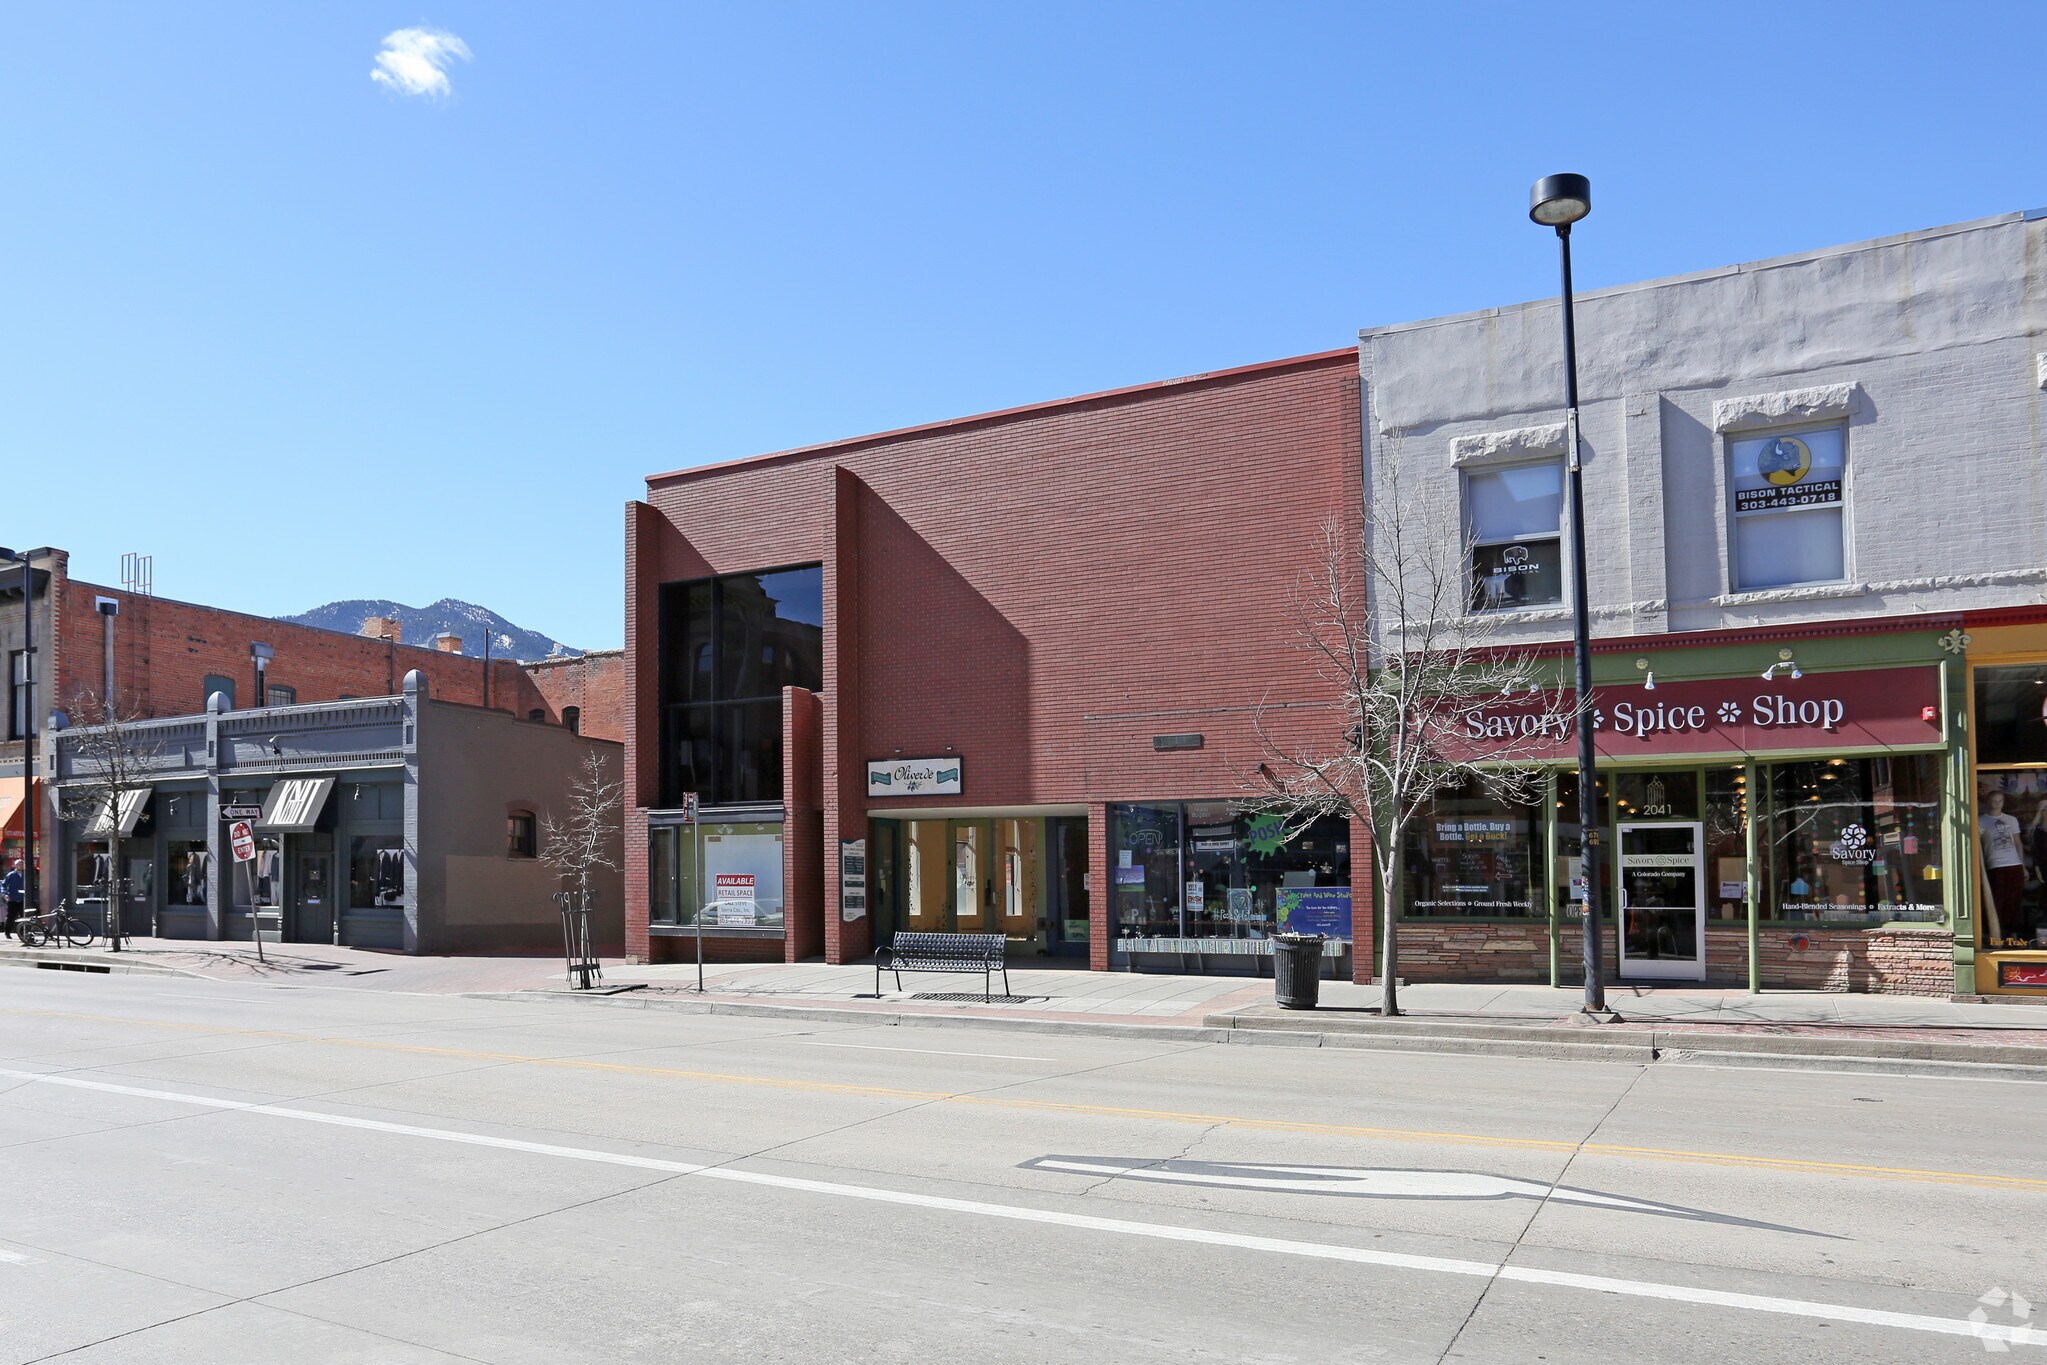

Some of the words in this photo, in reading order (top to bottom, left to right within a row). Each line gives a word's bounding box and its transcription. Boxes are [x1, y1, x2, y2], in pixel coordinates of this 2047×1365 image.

[1738, 489, 1776, 500] BISON
[1780, 482, 1839, 495] TACTICAL
[1741, 492, 1836, 510] 303-443-0718
[1493, 563, 1539, 574] BISON
[1465, 709, 1571, 742] Savory
[1613, 701, 1706, 738] Spice
[1752, 694, 1844, 730] Shop
[267, 779, 325, 825] KNIT
[1643, 804, 1672, 815] 2041
[242, 827, 250, 836] NOT
[1248, 820, 1284, 844] POSH
[1436, 822, 1457, 832] Bring
[1457, 824, 1463, 832] a
[1464, 822, 1489, 832] Bottle.
[1489, 822, 1505, 832] Buy
[1505, 824, 1511, 832] a
[1130, 832, 1160, 845] OPEN
[1439, 832, 1464, 841] Bottle.
[1465, 832, 1478, 841] Get
[1479, 833, 1484, 841] a
[1485, 832, 1508, 841] Buck!
[9, 848, 21, 858] BIG
[1832, 848, 1876, 861] Savory
[1627, 856, 1654, 865] Savory
[1667, 856, 1689, 865] Spice
[717, 877, 754, 885] AVAILABLE
[718, 889, 736, 897] RETAIL
[1513, 901, 1533, 909] Weekly
[1828, 903, 1867, 911] Seasonings
[1915, 903, 1935, 911] More
[1567, 906, 1583, 918] OPE
[1989, 936, 2004, 946] Fair
[2006, 936, 2028, 947] Trade
